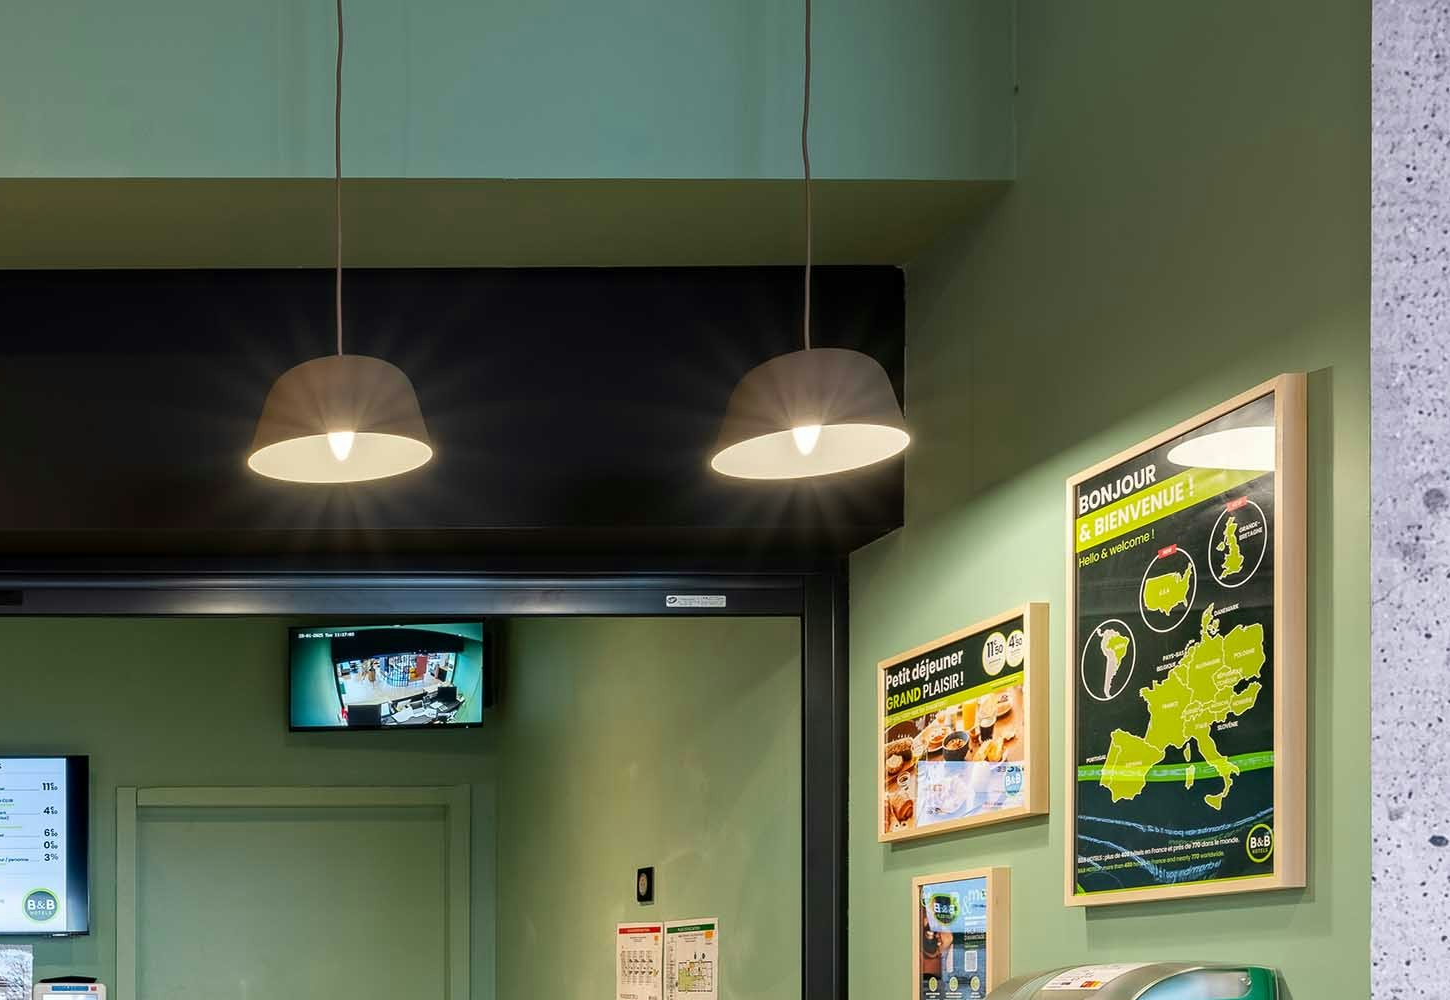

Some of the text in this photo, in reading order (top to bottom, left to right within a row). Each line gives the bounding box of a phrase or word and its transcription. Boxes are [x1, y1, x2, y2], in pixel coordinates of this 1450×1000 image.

[1079, 464, 1157, 515] BONJOUR
[1079, 524, 1091, 542] &
[1094, 482, 1184, 537] BIENVENUE
[1078, 552, 1099, 568] Hello
[1101, 548, 1108, 559] &
[1110, 532, 1150, 556] welcome
[886, 650, 964, 690] Petit déjeuner
[887, 687, 921, 711] GRAND
[923, 673, 959, 698] PLAISIR
[1250, 835, 1270, 849] B&B
[27, 899, 55, 910] B&B
